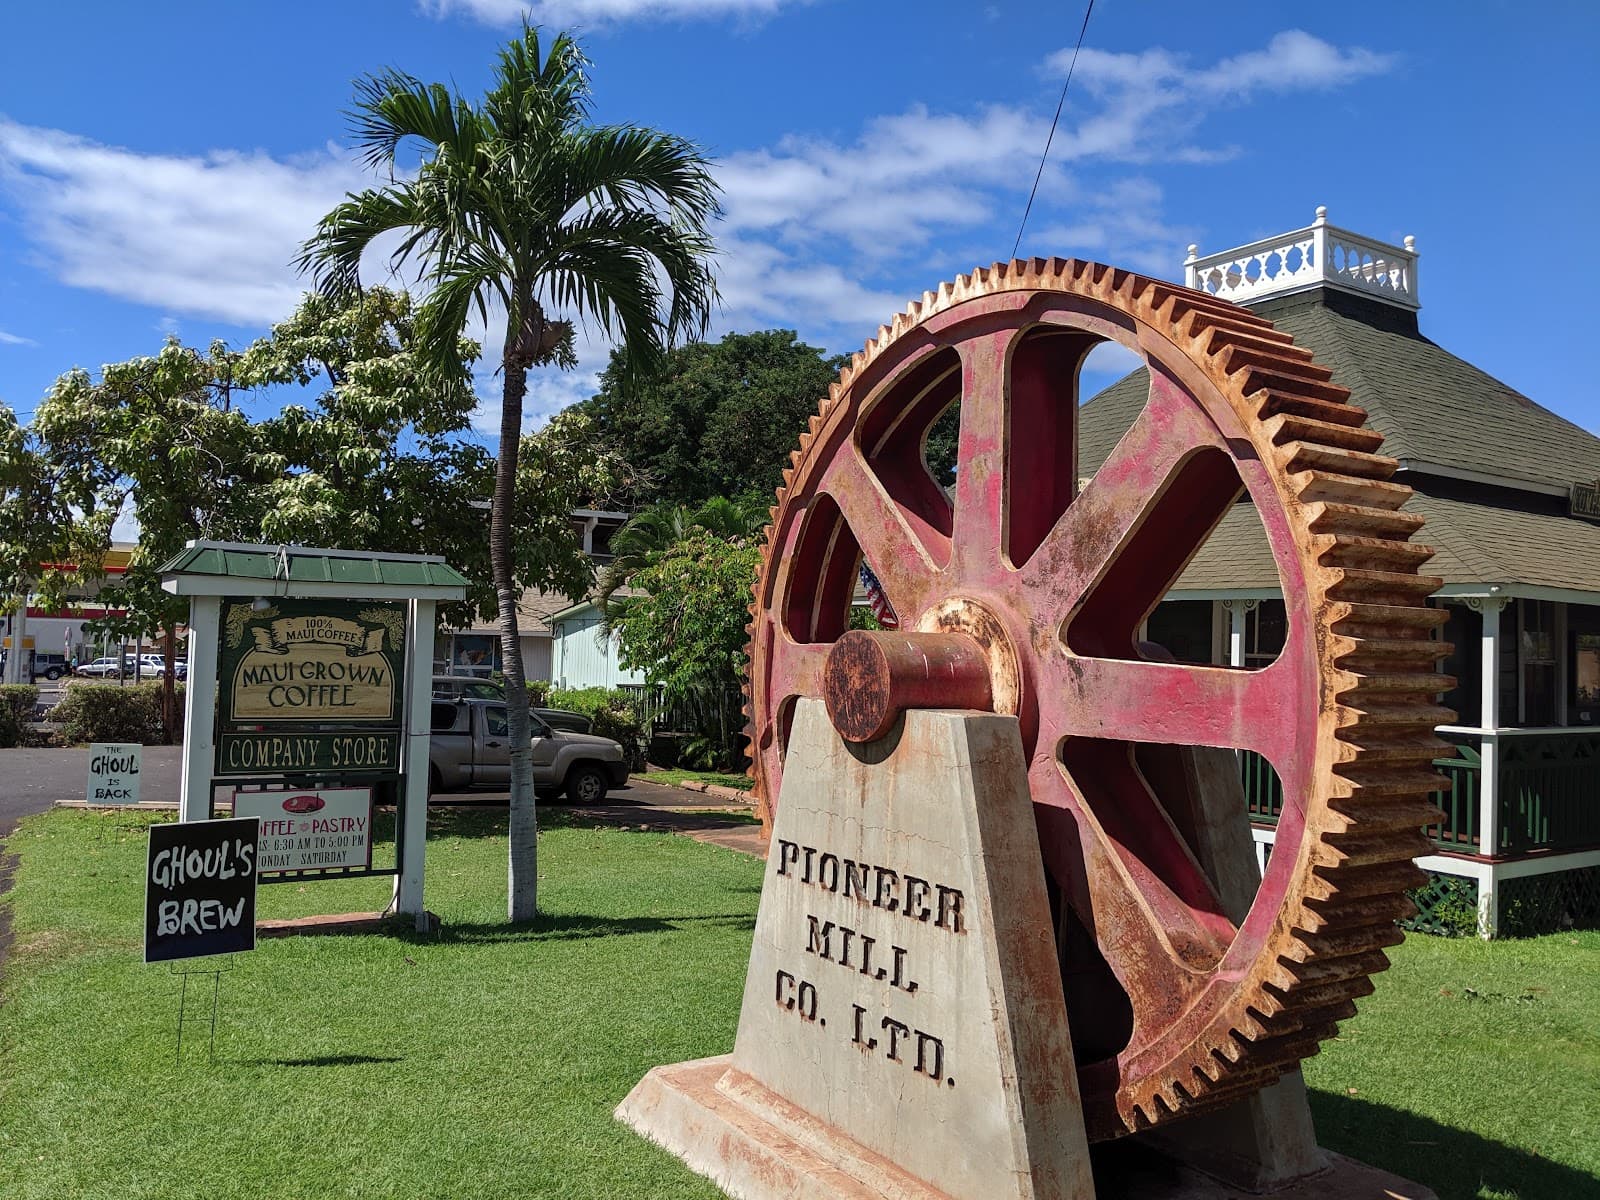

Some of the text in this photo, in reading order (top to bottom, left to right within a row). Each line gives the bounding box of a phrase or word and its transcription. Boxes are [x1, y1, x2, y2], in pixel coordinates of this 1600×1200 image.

[306, 618, 333, 629] 100%
[286, 629, 357, 642] MAUI COFFEE
[243, 661, 385, 687] MAUI GROWN
[268, 684, 357, 708] COFFEE
[104, 746, 122, 754] THE
[229, 737, 389, 768] COMPANY STORE
[91, 755, 139, 775] GHOUL
[95, 788, 132, 799] BACK
[260, 817, 366, 836] FFEE PASTRY
[274, 839, 294, 851] 6:30
[297, 837, 311, 850] AM
[315, 837, 326, 848] TO
[328, 836, 349, 848] 5:00
[352, 835, 365, 847] PM
[152, 839, 254, 890] GHOUL'S
[301, 851, 347, 865] SATURDAY
[777, 839, 967, 935] PIONEER
[157, 897, 245, 936] BREW
[806, 915, 919, 993] MILL
[776, 969, 956, 1088] CO. LTD.
